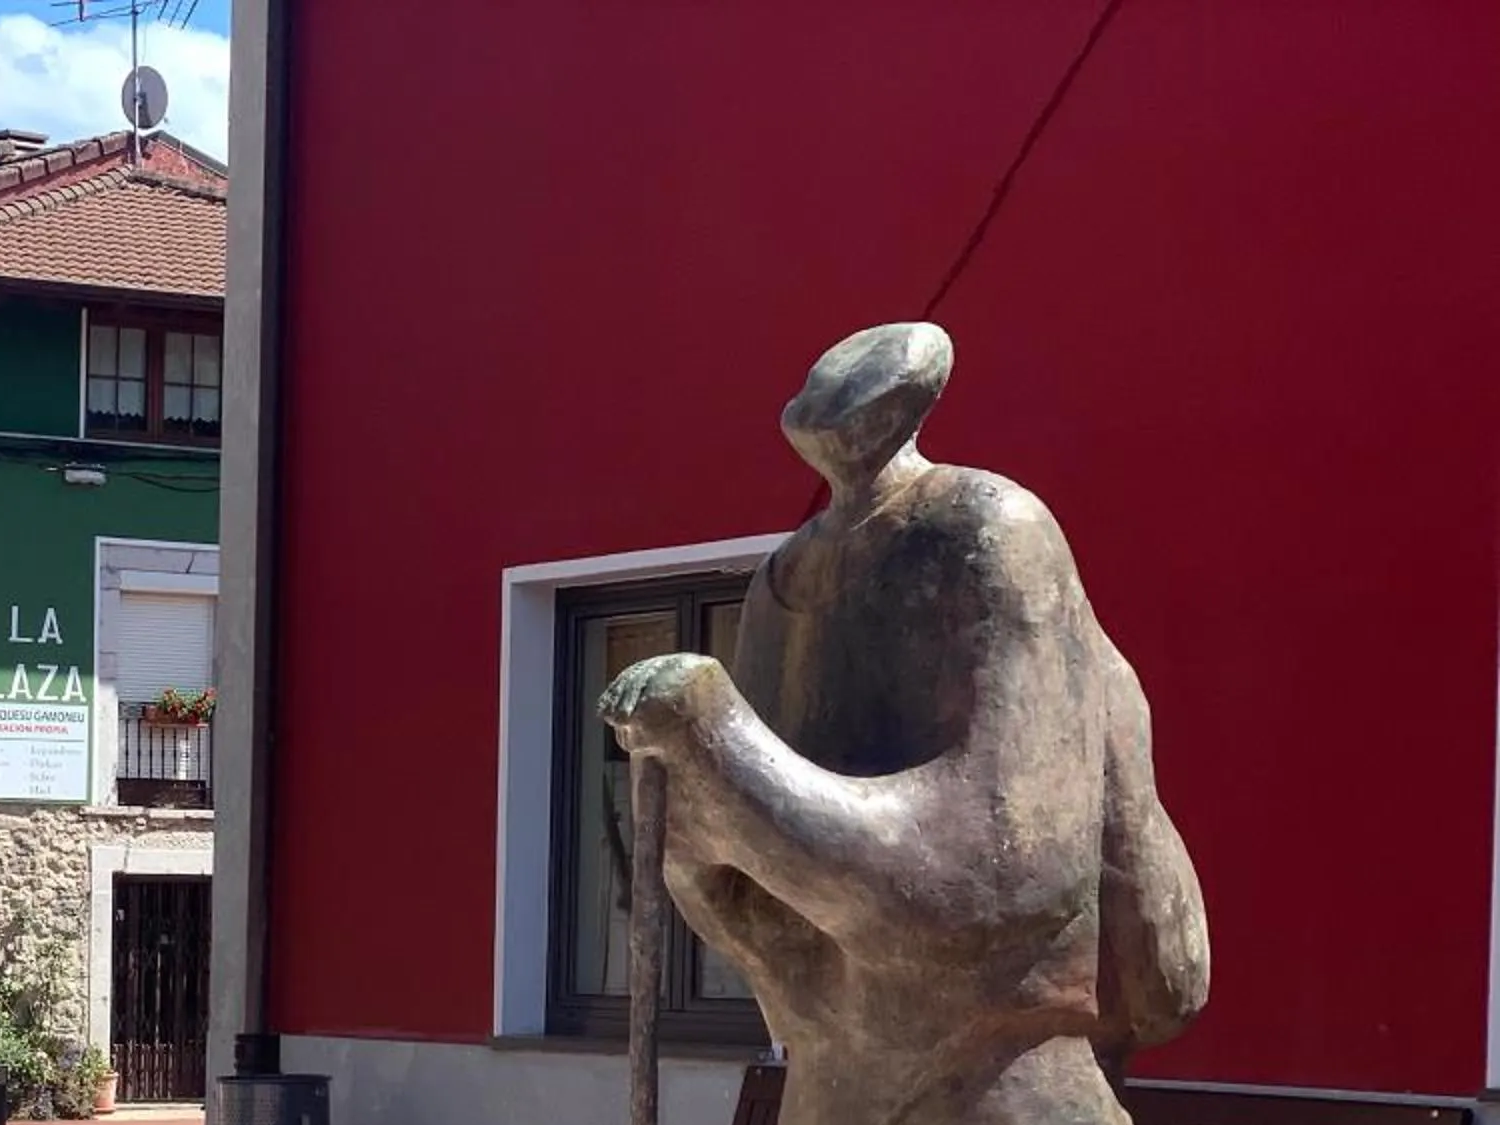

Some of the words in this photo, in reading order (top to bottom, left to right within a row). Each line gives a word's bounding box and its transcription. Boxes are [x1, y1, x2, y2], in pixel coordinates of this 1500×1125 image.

[8, 605, 63, 644] LA
[0, 709, 33, 721] QUESU
[34, 711, 85, 723] GAMONEU
